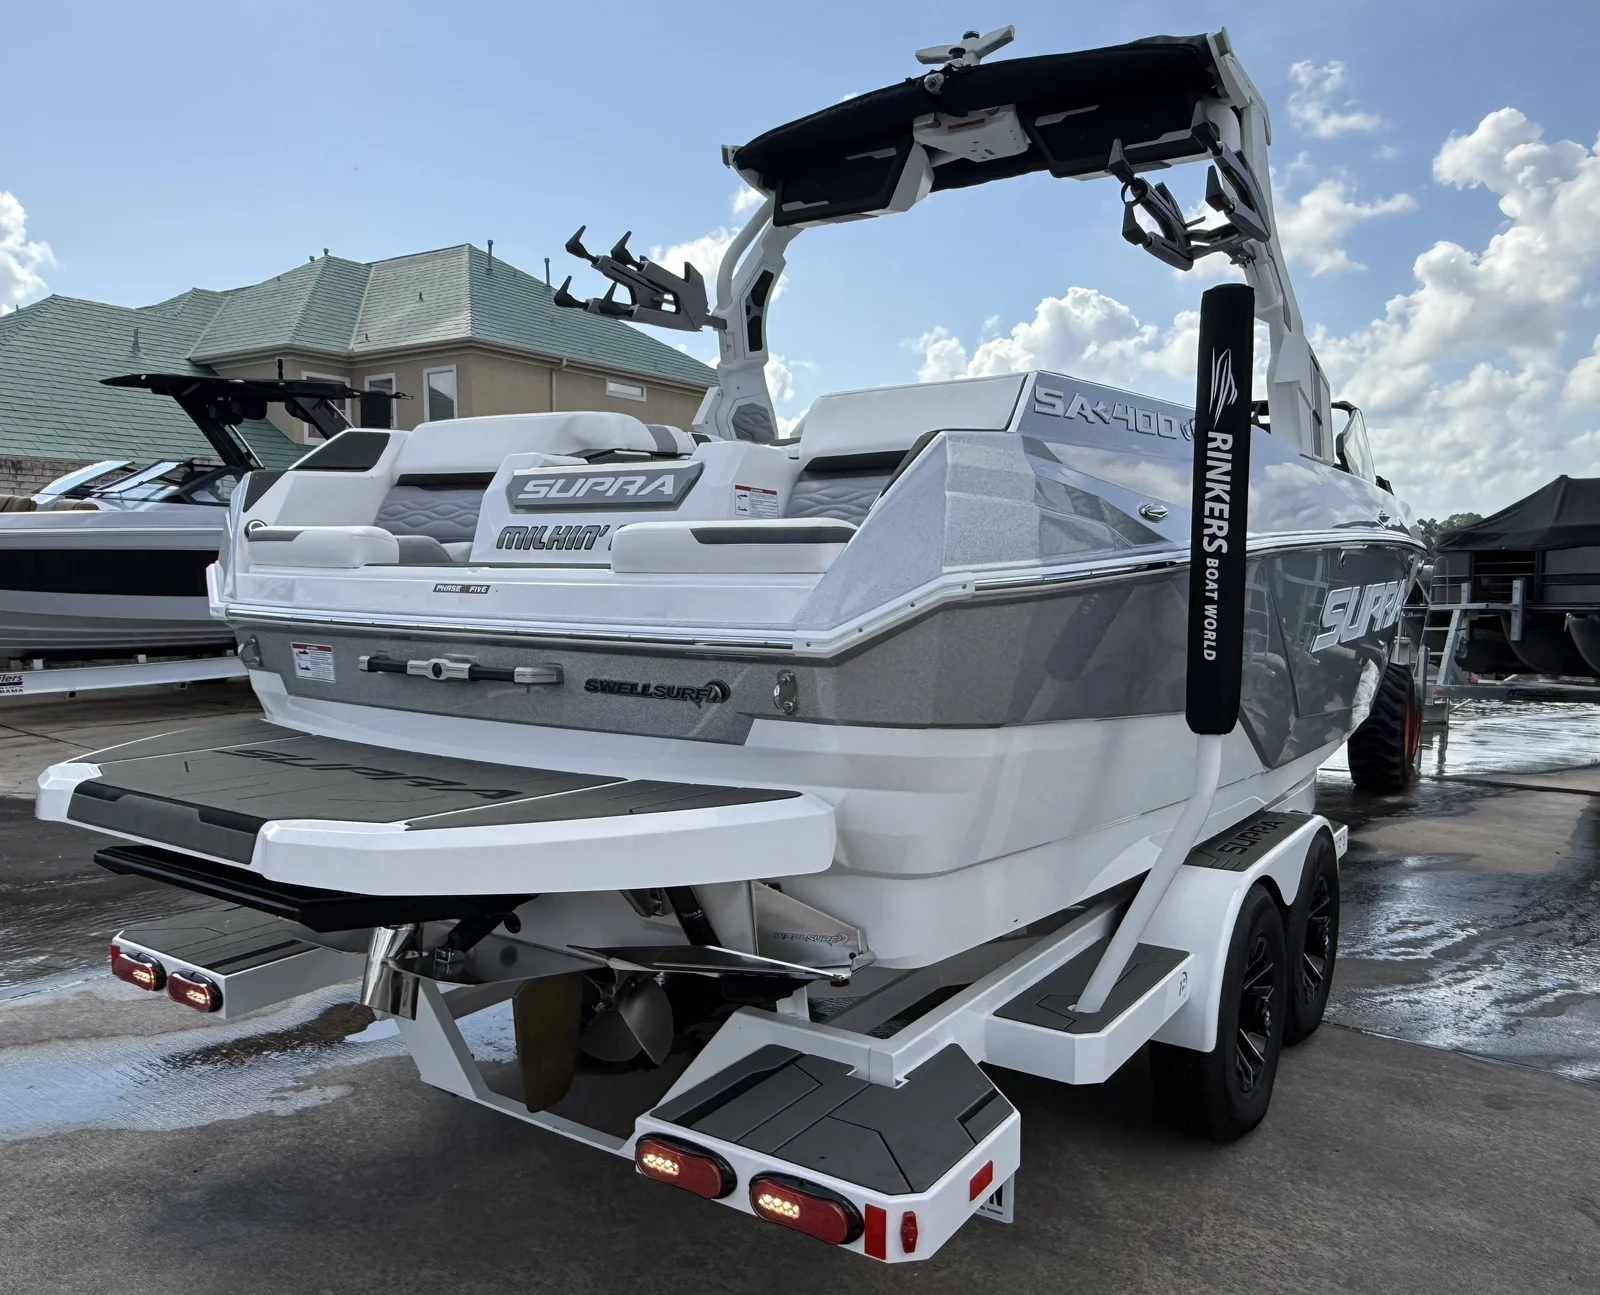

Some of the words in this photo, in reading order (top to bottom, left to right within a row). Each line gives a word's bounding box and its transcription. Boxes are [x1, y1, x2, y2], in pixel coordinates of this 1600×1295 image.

[517, 474, 675, 499] SUPRA
[1202, 431, 1233, 554] RINKERS
[436, 584, 462, 593] PHASE
[1205, 557, 1219, 601] BOAT
[1203, 604, 1218, 661] WORLD
[584, 678, 714, 707] SWELLSURF
[1216, 820, 1286, 855] SUPRA
